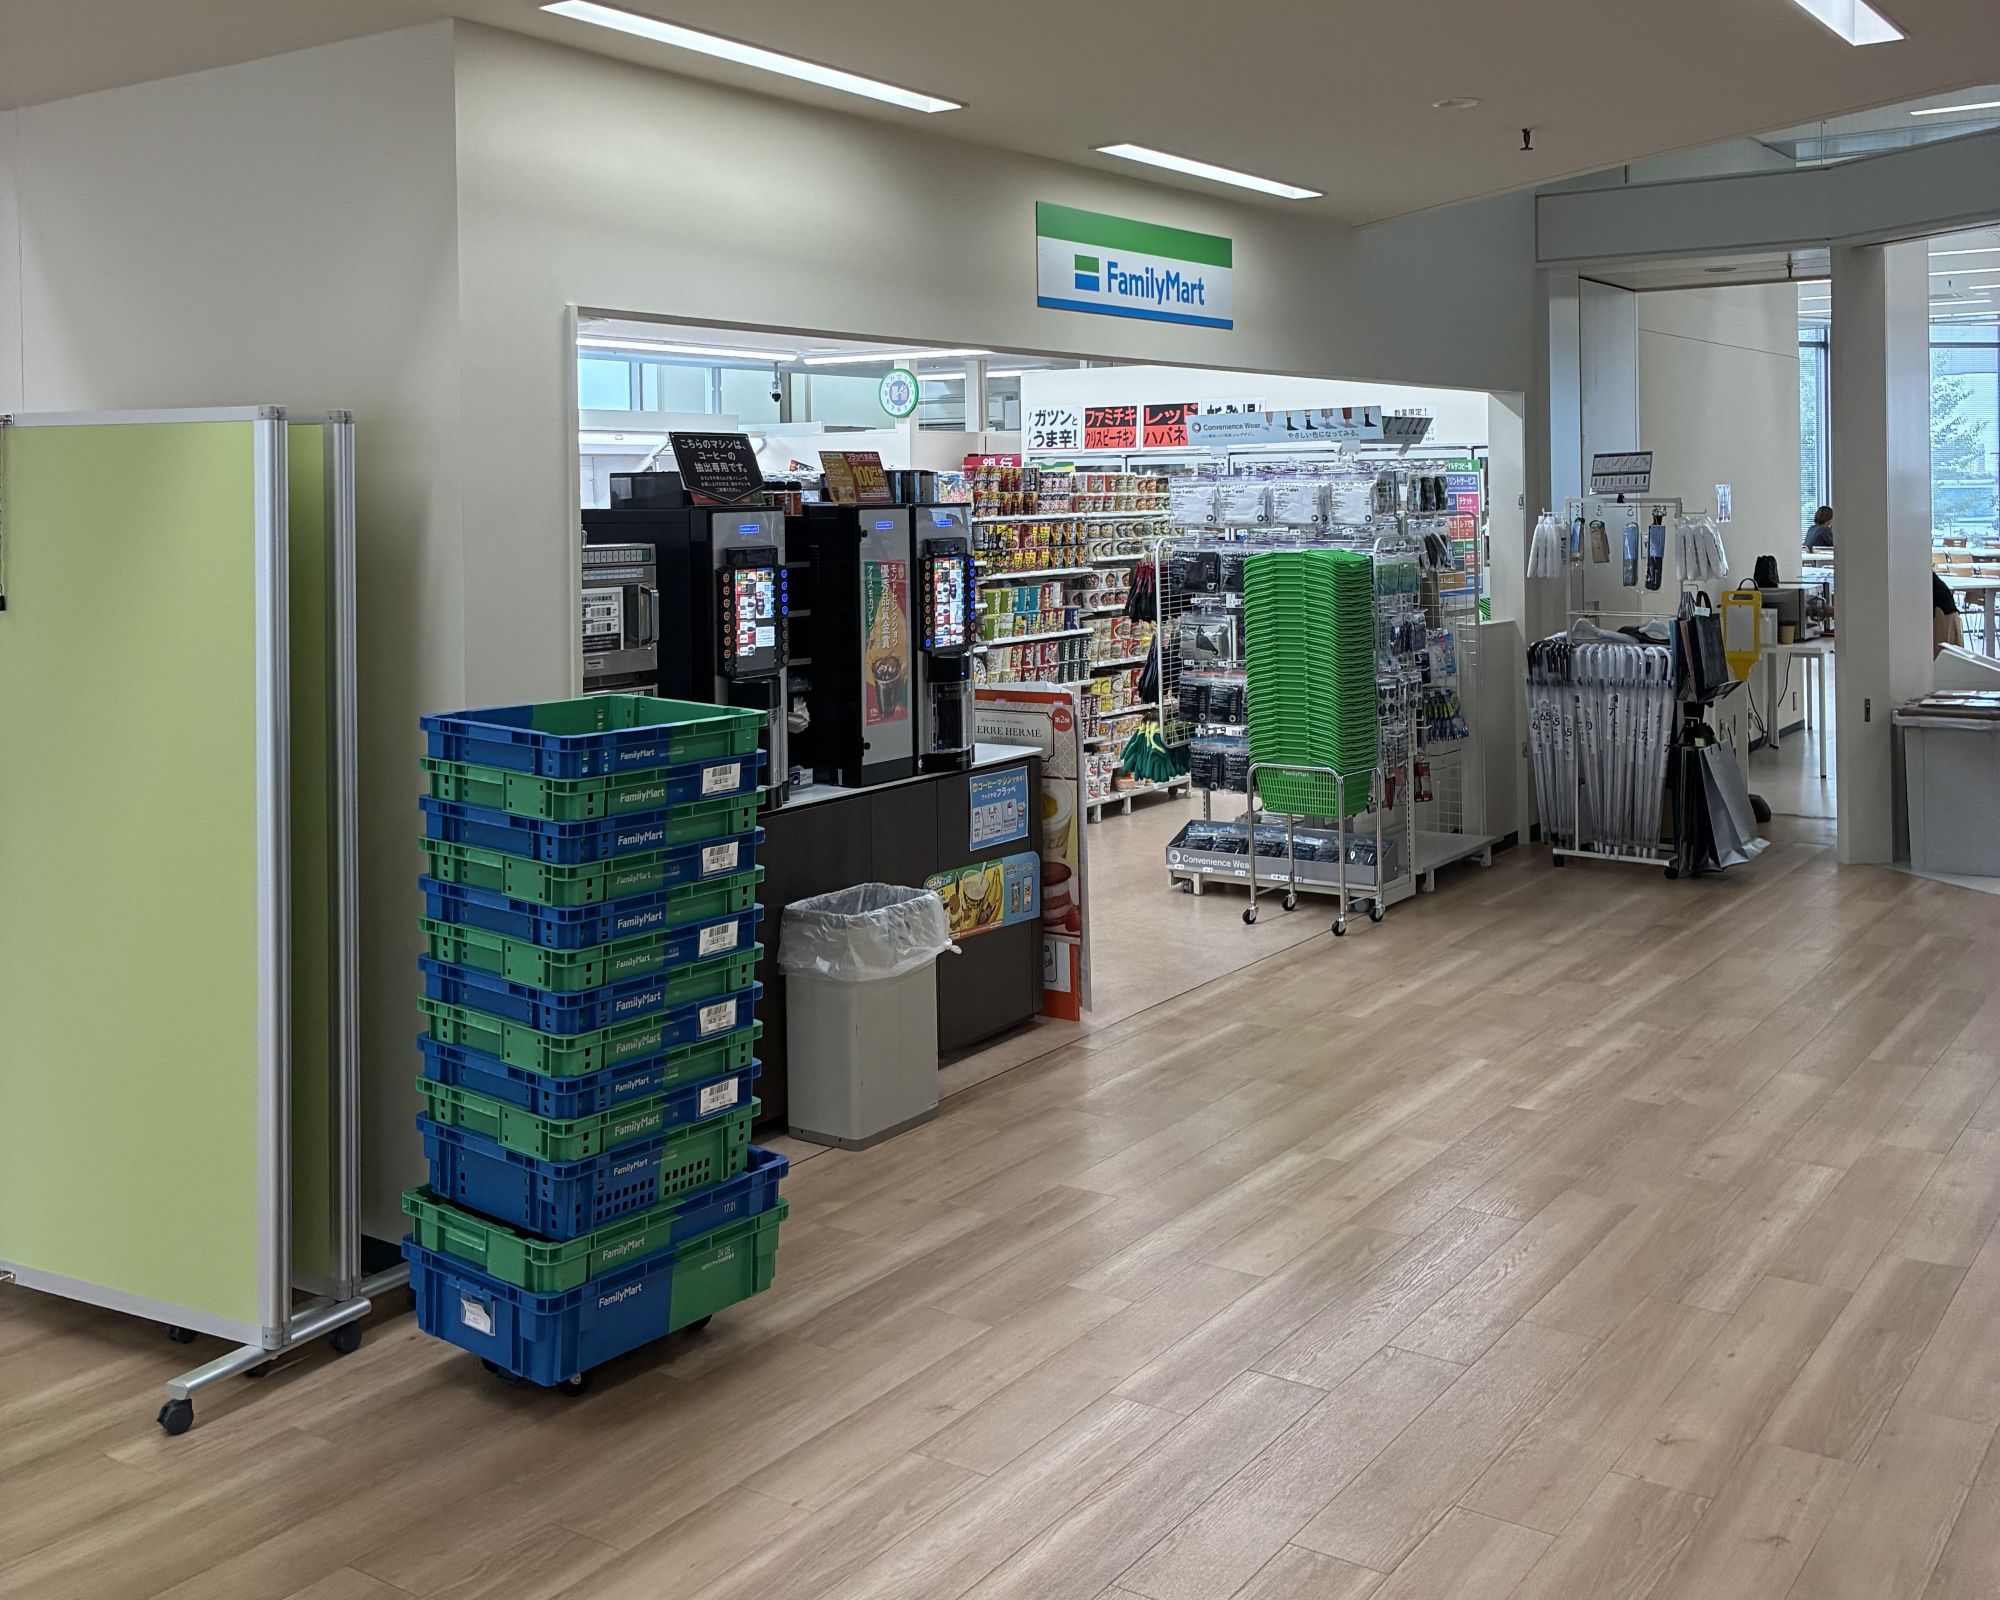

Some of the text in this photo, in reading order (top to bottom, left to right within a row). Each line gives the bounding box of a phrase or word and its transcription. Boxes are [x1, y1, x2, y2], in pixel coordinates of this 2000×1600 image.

[1107, 260, 1205, 305] FamilyMart
[1035, 409, 1078, 427] ガツンと
[1085, 407, 1136, 427] ファミチキ
[1203, 421, 1261, 431] Convenience Wear
[680, 439, 747, 450] こちらのマシンは、
[1033, 430, 1077, 448] うま辛!
[1085, 428, 1136, 447] クリスピーチキン
[1144, 427, 1186, 446] ハバネ
[698, 451, 736, 460] コーヒーの
[694, 462, 748, 473] 抽出専用です。
[620, 749, 655, 761] FamilyMart
[620, 788, 665, 804] FamilyMart
[618, 829, 663, 846] FamilyMart
[1182, 854, 1250, 869] Convenience Wea
[616, 871, 651, 885] FamilyMart
[617, 910, 663, 930] FamilyMart
[616, 954, 651, 969] FamilyMart
[616, 991, 661, 1012] FamilyMart
[616, 1032, 661, 1054] FamilyMart
[615, 1076, 650, 1093] FamilyMart
[614, 1113, 660, 1137] FamilyMart
[613, 1157, 648, 1176] FamilyMart
[602, 1236, 646, 1261] FamilyMart
[598, 1282, 643, 1309] FamilyMart
